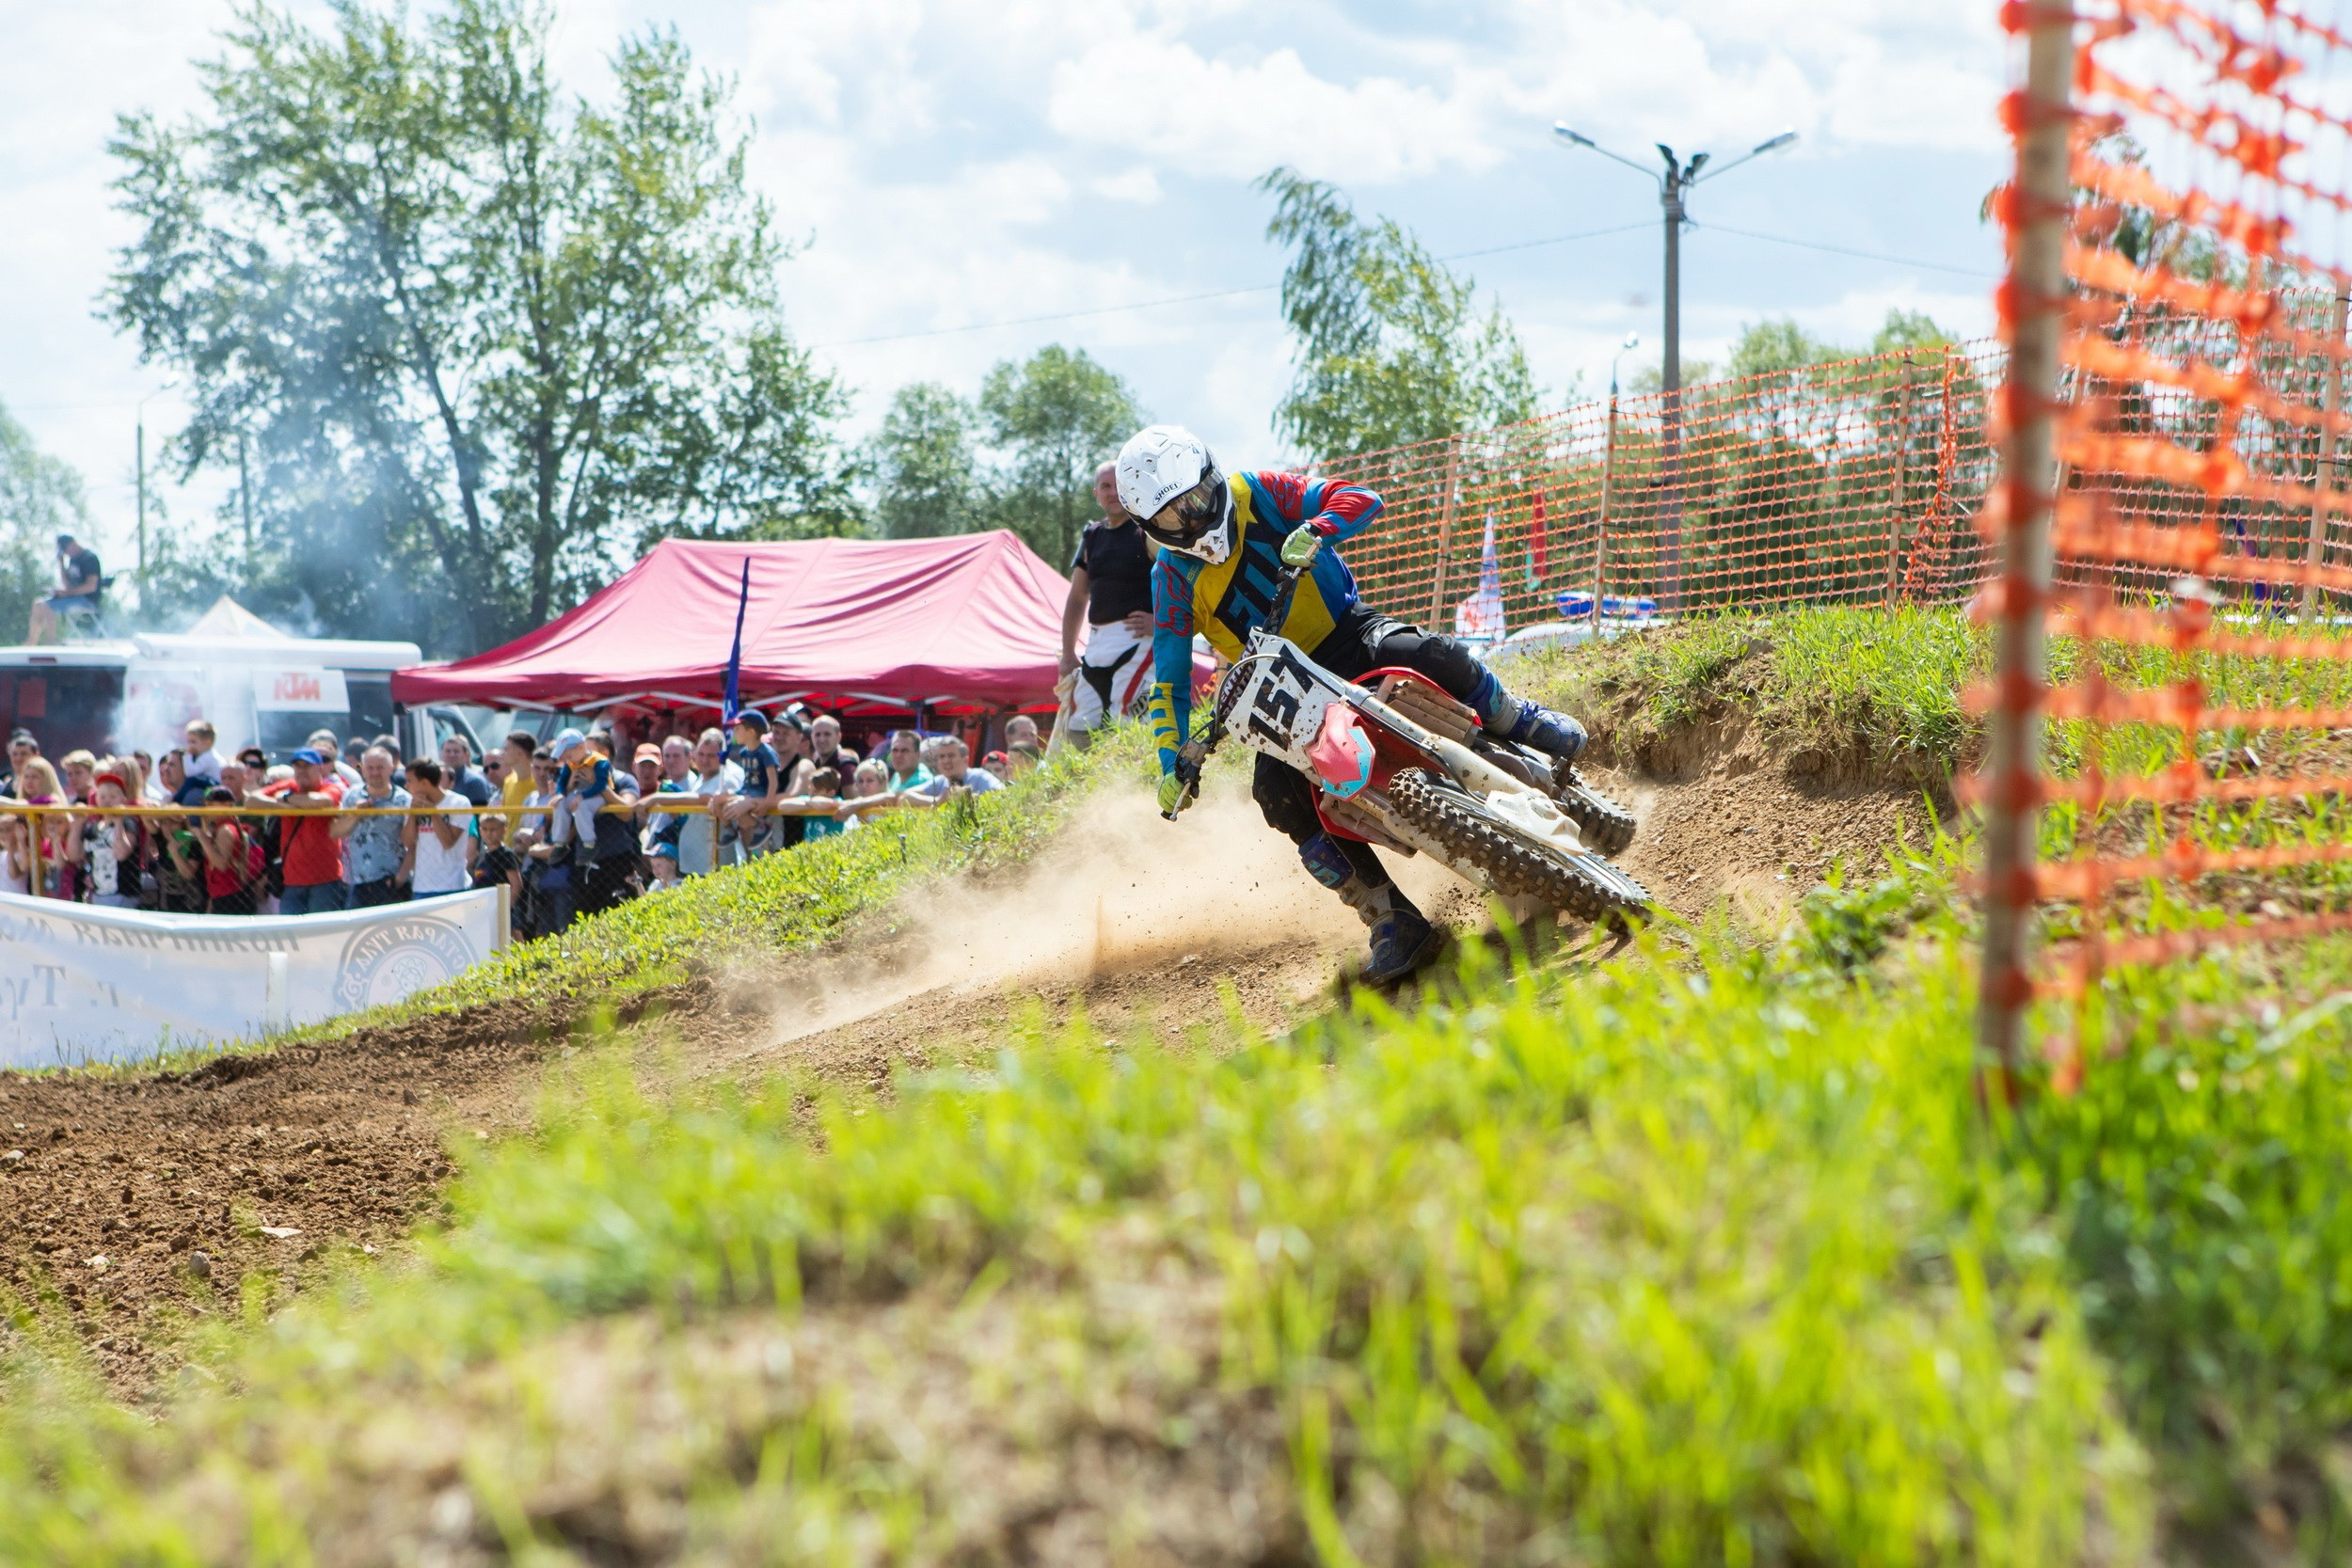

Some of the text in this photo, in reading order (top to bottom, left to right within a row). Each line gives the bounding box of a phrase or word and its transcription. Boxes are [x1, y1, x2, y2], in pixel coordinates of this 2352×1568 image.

[1155, 483, 1179, 502] SHOEI
[274, 672, 321, 702] KTM
[1248, 643, 1314, 752] 157
